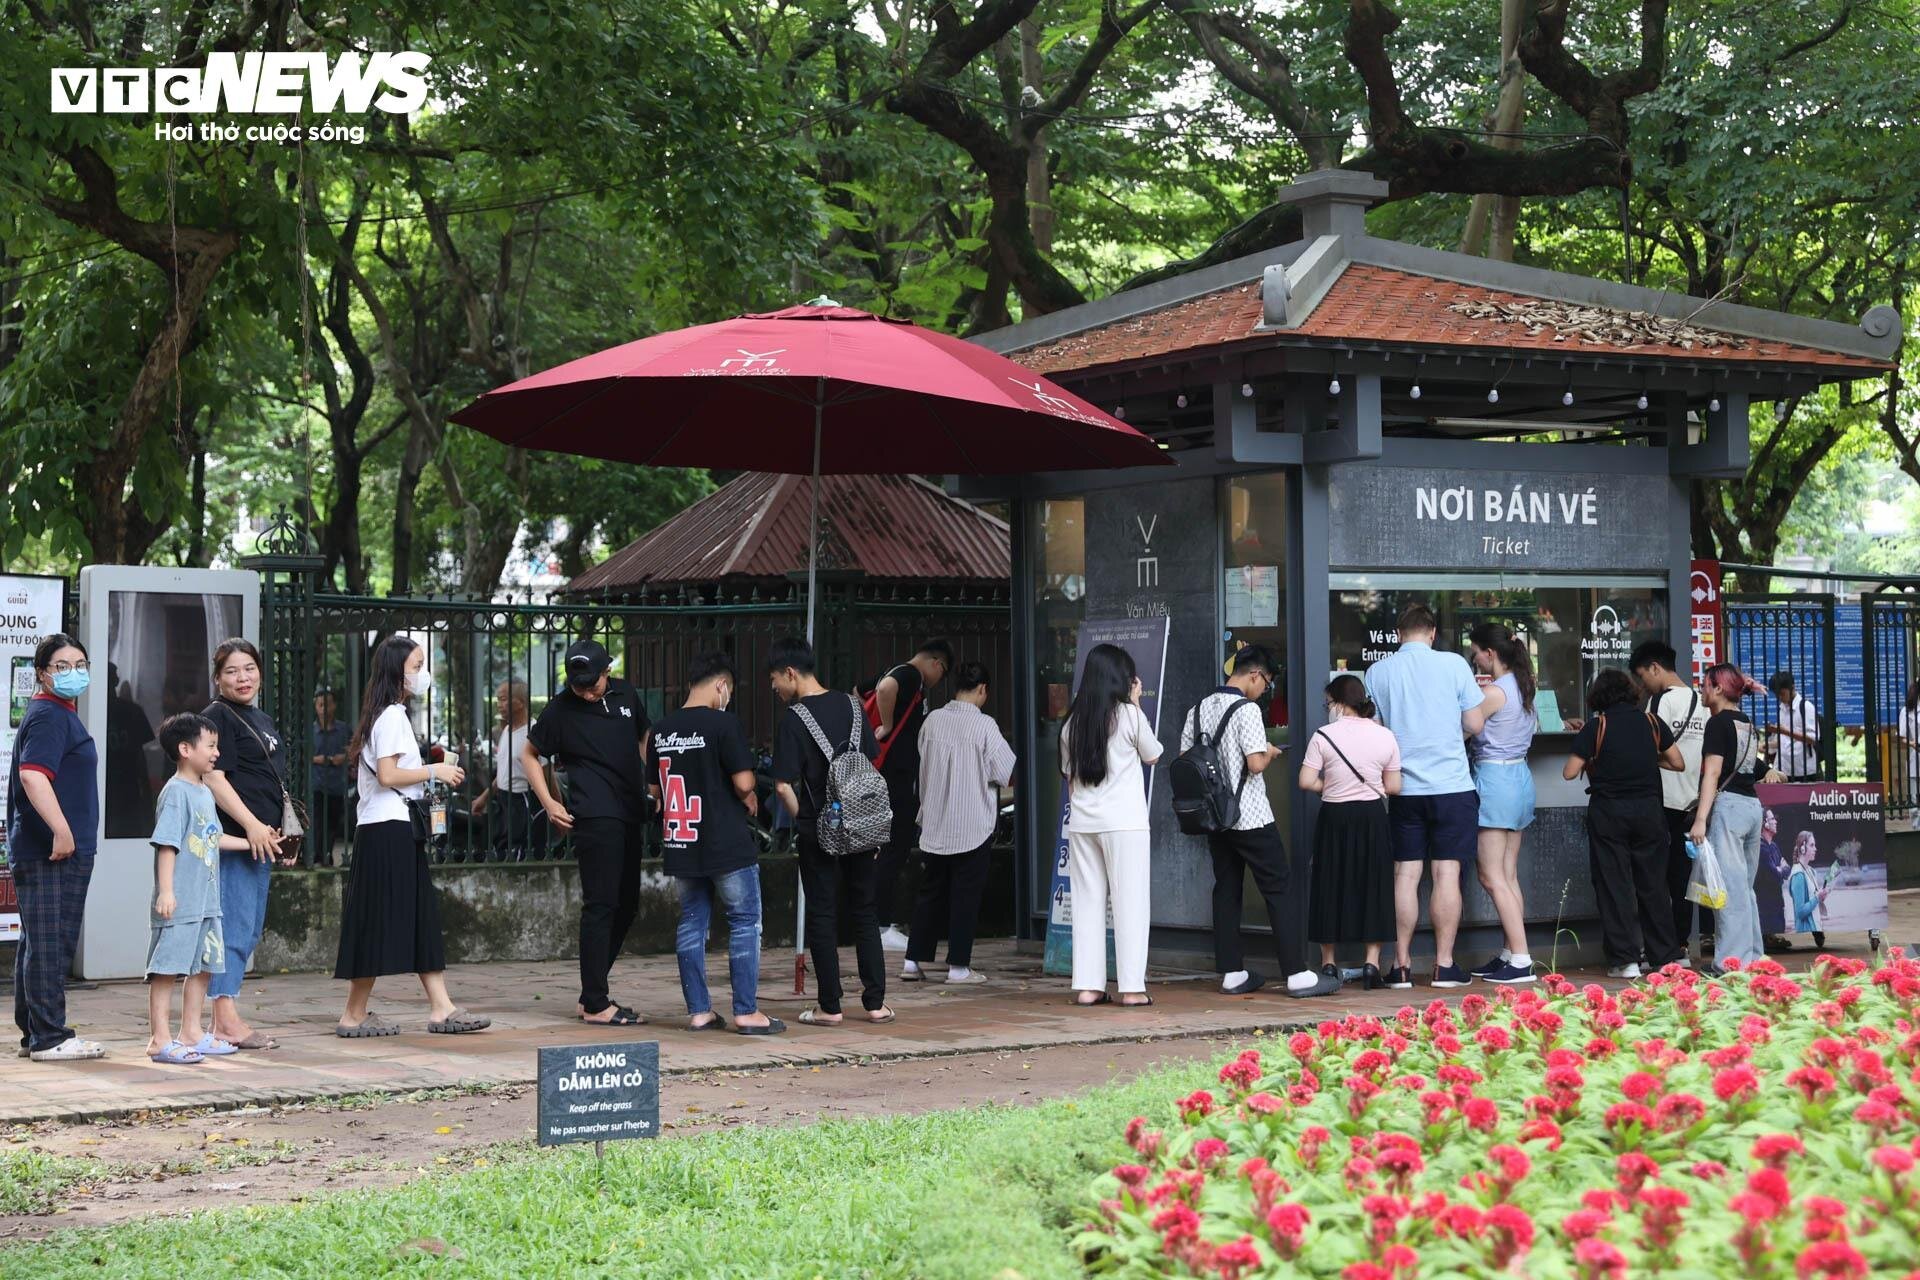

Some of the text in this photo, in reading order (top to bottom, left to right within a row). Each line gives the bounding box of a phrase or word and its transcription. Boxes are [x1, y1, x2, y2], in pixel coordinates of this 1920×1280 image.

[1416, 484, 1598, 525] NƠI BÁN VÉ
[1482, 536, 1530, 555] Ticket
[1126, 600, 1170, 619] Văn Miếu
[1369, 629, 1399, 644] Vé và
[1581, 637, 1632, 650] Audio Tour
[665, 731, 706, 754] Angeles
[659, 757, 702, 842] LA
[1809, 789, 1880, 806] Audio Tour
[1810, 811, 1834, 822] Thuyết
[1834, 810, 1852, 820] minh
[1861, 810, 1879, 821] động
[1054, 883, 1064, 907] 4
[575, 1052, 627, 1070] KHÔNG
[595, 1072, 621, 1089] LÊN
[623, 1069, 643, 1087] CỎ
[569, 1101, 632, 1114] Keep off the grass
[550, 1119, 650, 1136] Ne pas marcher sur l'herbe
